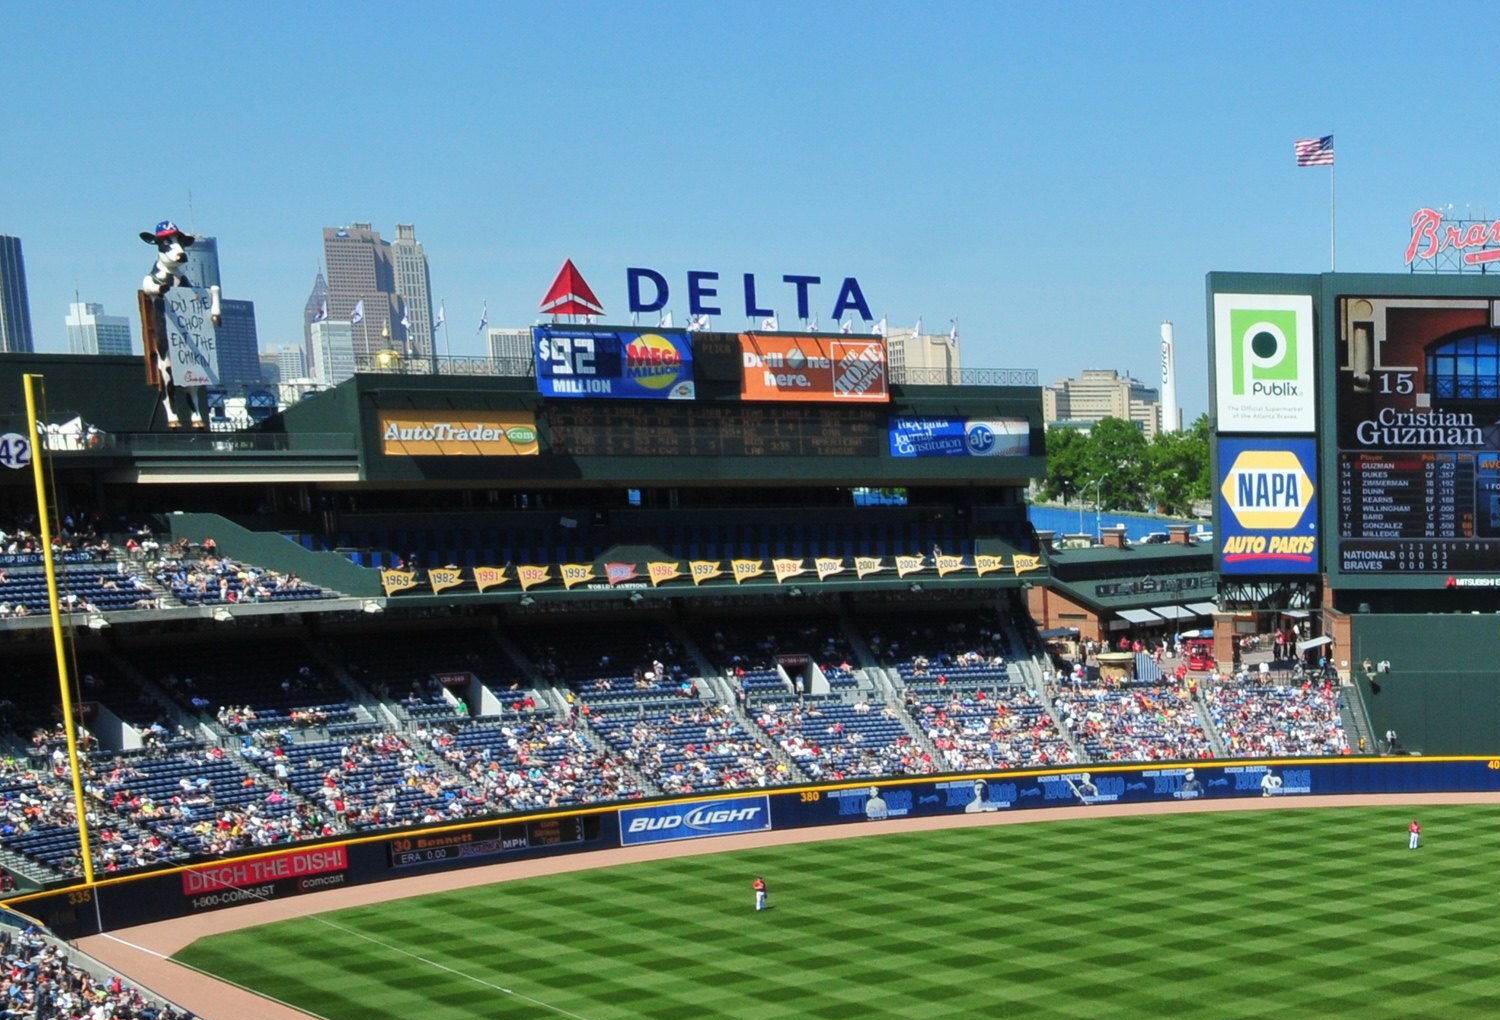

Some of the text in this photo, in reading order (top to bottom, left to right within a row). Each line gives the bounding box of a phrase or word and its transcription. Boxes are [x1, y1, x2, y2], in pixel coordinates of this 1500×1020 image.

[626, 266, 874, 321] DELTA
[190, 296, 211, 314] THE
[177, 315, 205, 330] CHOP
[171, 332, 215, 352] EAT THE
[625, 343, 683, 367] MEGA
[743, 352, 784, 368] Drill
[838, 348, 860, 370] THE
[834, 343, 882, 396] HOME
[553, 379, 612, 394] MILLION
[764, 371, 811, 387] here.
[854, 362, 883, 396] DEPOT
[1379, 372, 1415, 394] 15
[1252, 381, 1298, 396] Publix
[1378, 407, 1475, 427] Cristian
[970, 429, 993, 448] ajc
[1356, 420, 1485, 445] Guzman
[0, 439, 29, 464] 42
[899, 438, 962, 455] Constitution
[1362, 471, 1388, 479] DUKES
[1238, 473, 1299, 508] NAPA
[1362, 522, 1403, 530] GONZALEZ
[1223, 535, 1316, 555] AUTO PARTS
[1015, 558, 1034, 568] 2005
[1343, 551, 1396, 560] NATIONALS
[652, 566, 673, 576] 1996
[694, 565, 714, 575] 1997
[736, 563, 757, 573] 1998
[776, 563, 797, 573] 1999
[819, 562, 837, 571] 2000
[858, 561, 876, 570] 2001
[900, 560, 917, 569] 2002
[939, 559, 957, 569] 2003
[978, 559, 996, 568] 2004
[1344, 561, 1383, 570] BRAVES
[386, 575, 409, 586] 1969
[432, 572, 455, 584] 1982
[478, 571, 500, 582] 1991
[522, 570, 543, 581] 1992
[564, 568, 587, 578] 1993
[1456, 578, 1494, 586] MITSUBISHI
[801, 791, 820, 802] 380
[628, 806, 762, 833] BUD LIGHT
[393, 833, 473, 852] 30 Bennett
[502, 838, 527, 849] MPH
[401, 853, 421, 864] ERA
[426, 849, 447, 861] 0.00
[188, 849, 343, 892] DITCH THE DISH!
[301, 873, 345, 889] comcast
[69, 890, 91, 905] 335
[191, 884, 276, 909] 1-800-COMCAST
